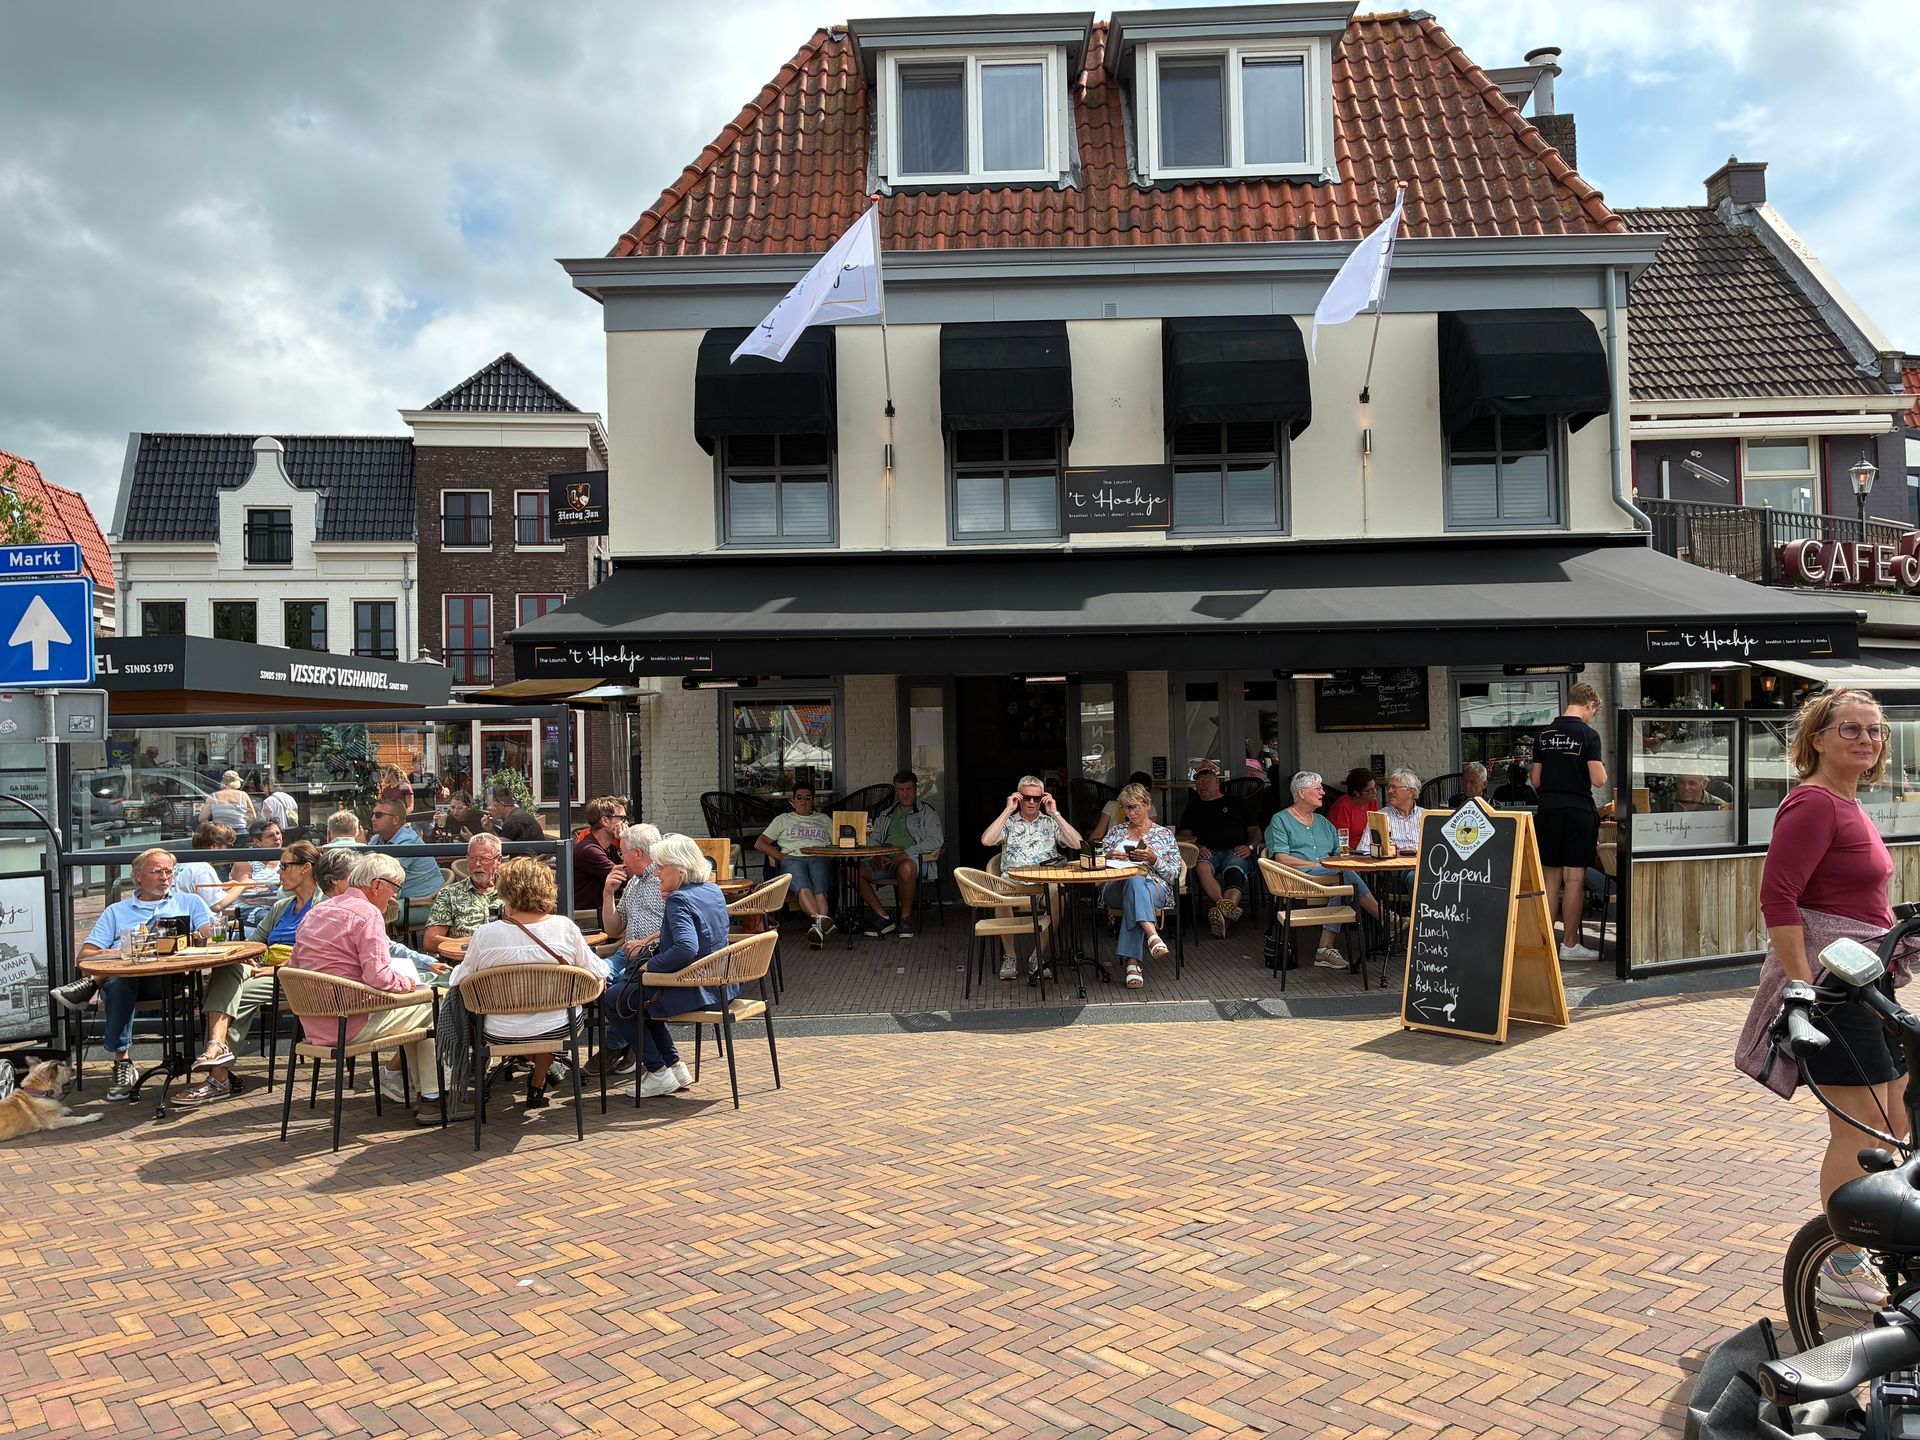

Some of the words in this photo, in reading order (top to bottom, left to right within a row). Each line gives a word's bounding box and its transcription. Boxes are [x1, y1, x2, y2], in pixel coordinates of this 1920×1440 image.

[1092, 487, 1166, 516] Hoekje
[557, 511, 583, 523] Hertog
[583, 509, 599, 521] Jan
[9, 551, 61, 567] Markt
[1699, 629, 1759, 656] Hoekje
[587, 644, 645, 673] Hoekje
[125, 665, 151, 674] SINDS
[152, 663, 174, 673] 1979
[260, 670, 275, 681] SINDS
[274, 671, 287, 681] 1979
[289, 663, 336, 685] VISSER'S
[337, 667, 388, 689] VISHANDEL
[388, 682, 400, 691] SINDS
[399, 683, 409, 692] 1979
[786, 827, 796, 836] LE
[1663, 817, 1692, 839] Hoekje
[1428, 843, 1491, 903] Geopend
[1420, 903, 1471, 924] Breakfast
[1419, 921, 1449, 940] Lunch
[1417, 941, 1449, 958] Drinks
[1, 956, 28, 972] VANAF
[1416, 959, 1448, 973] Dinner
[8, 969, 28, 982] UUR
